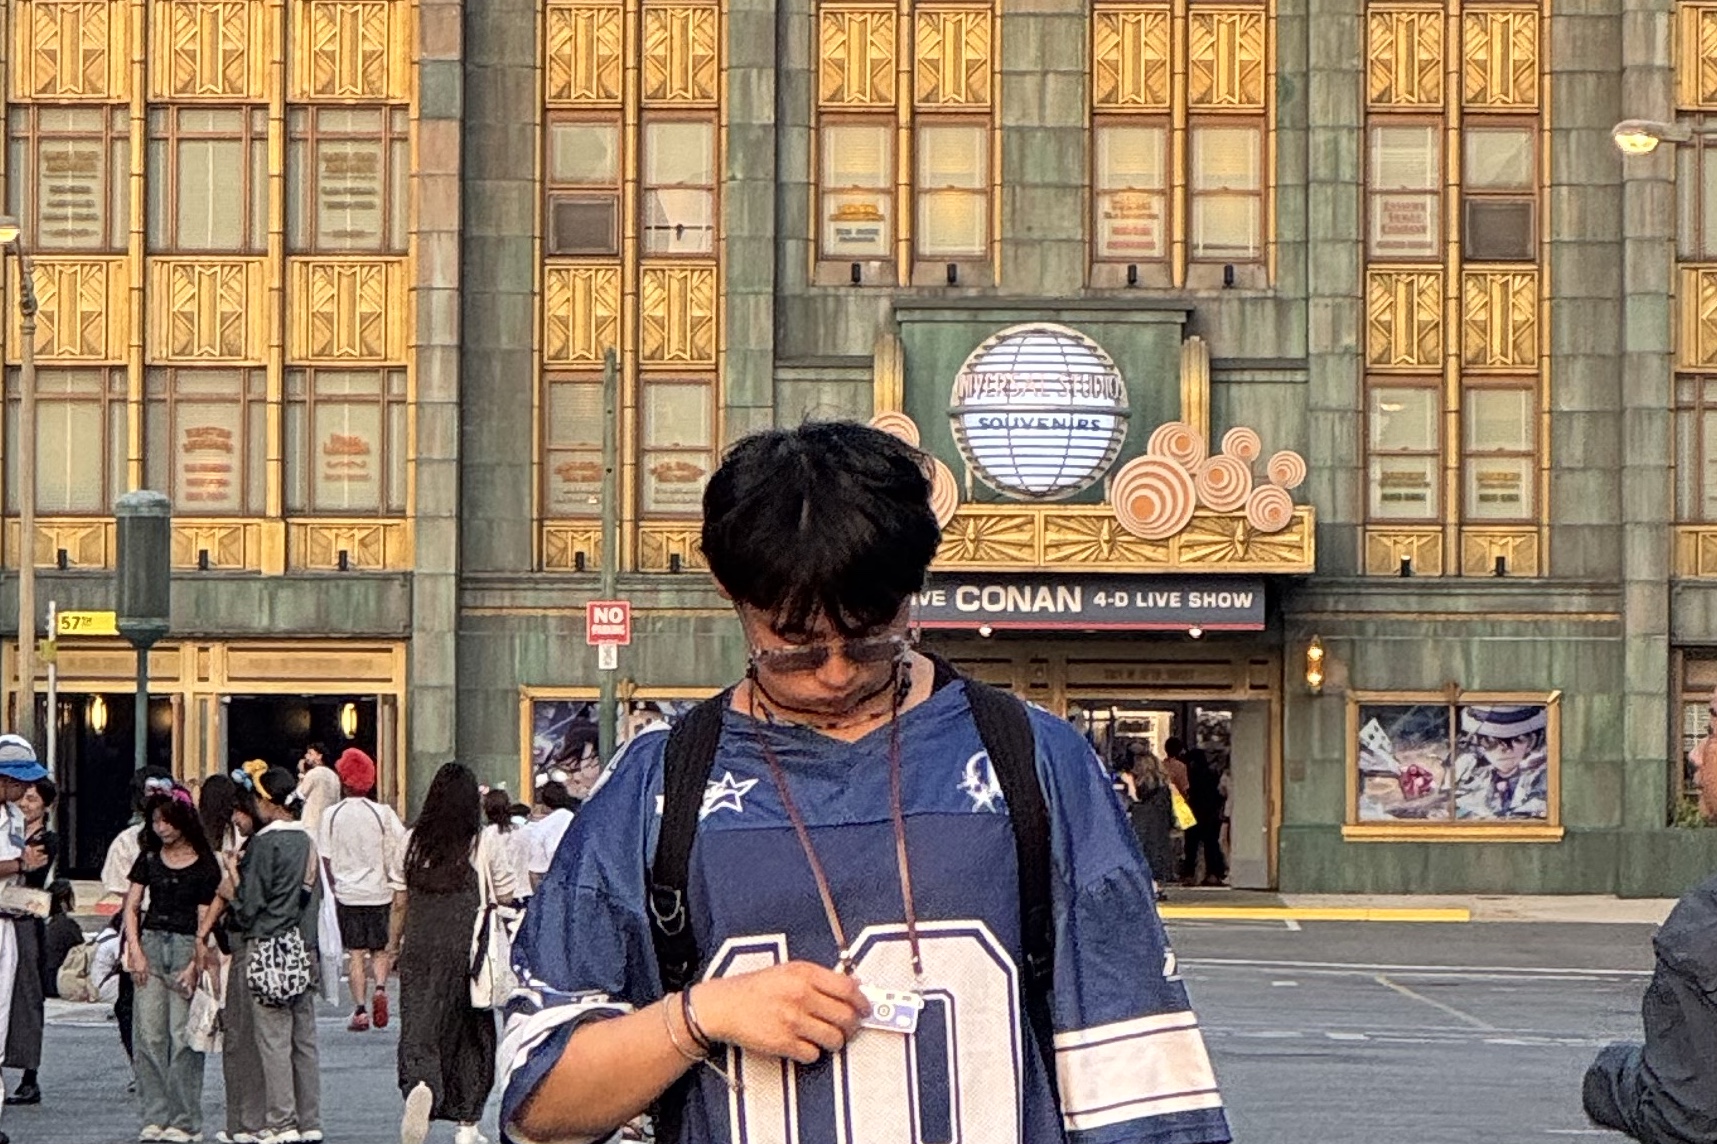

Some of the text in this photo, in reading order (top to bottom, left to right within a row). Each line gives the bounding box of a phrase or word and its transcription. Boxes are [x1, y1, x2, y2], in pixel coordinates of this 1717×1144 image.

[957, 372, 1121, 399] NIVERSAL STUDIO
[978, 417, 1101, 431] SOUVENIRS
[955, 585, 1082, 613] CONAN
[1093, 591, 1129, 608] 4-D
[1136, 591, 1182, 608] LIVE
[1188, 591, 1254, 608] SHOW
[593, 606, 624, 624] NO
